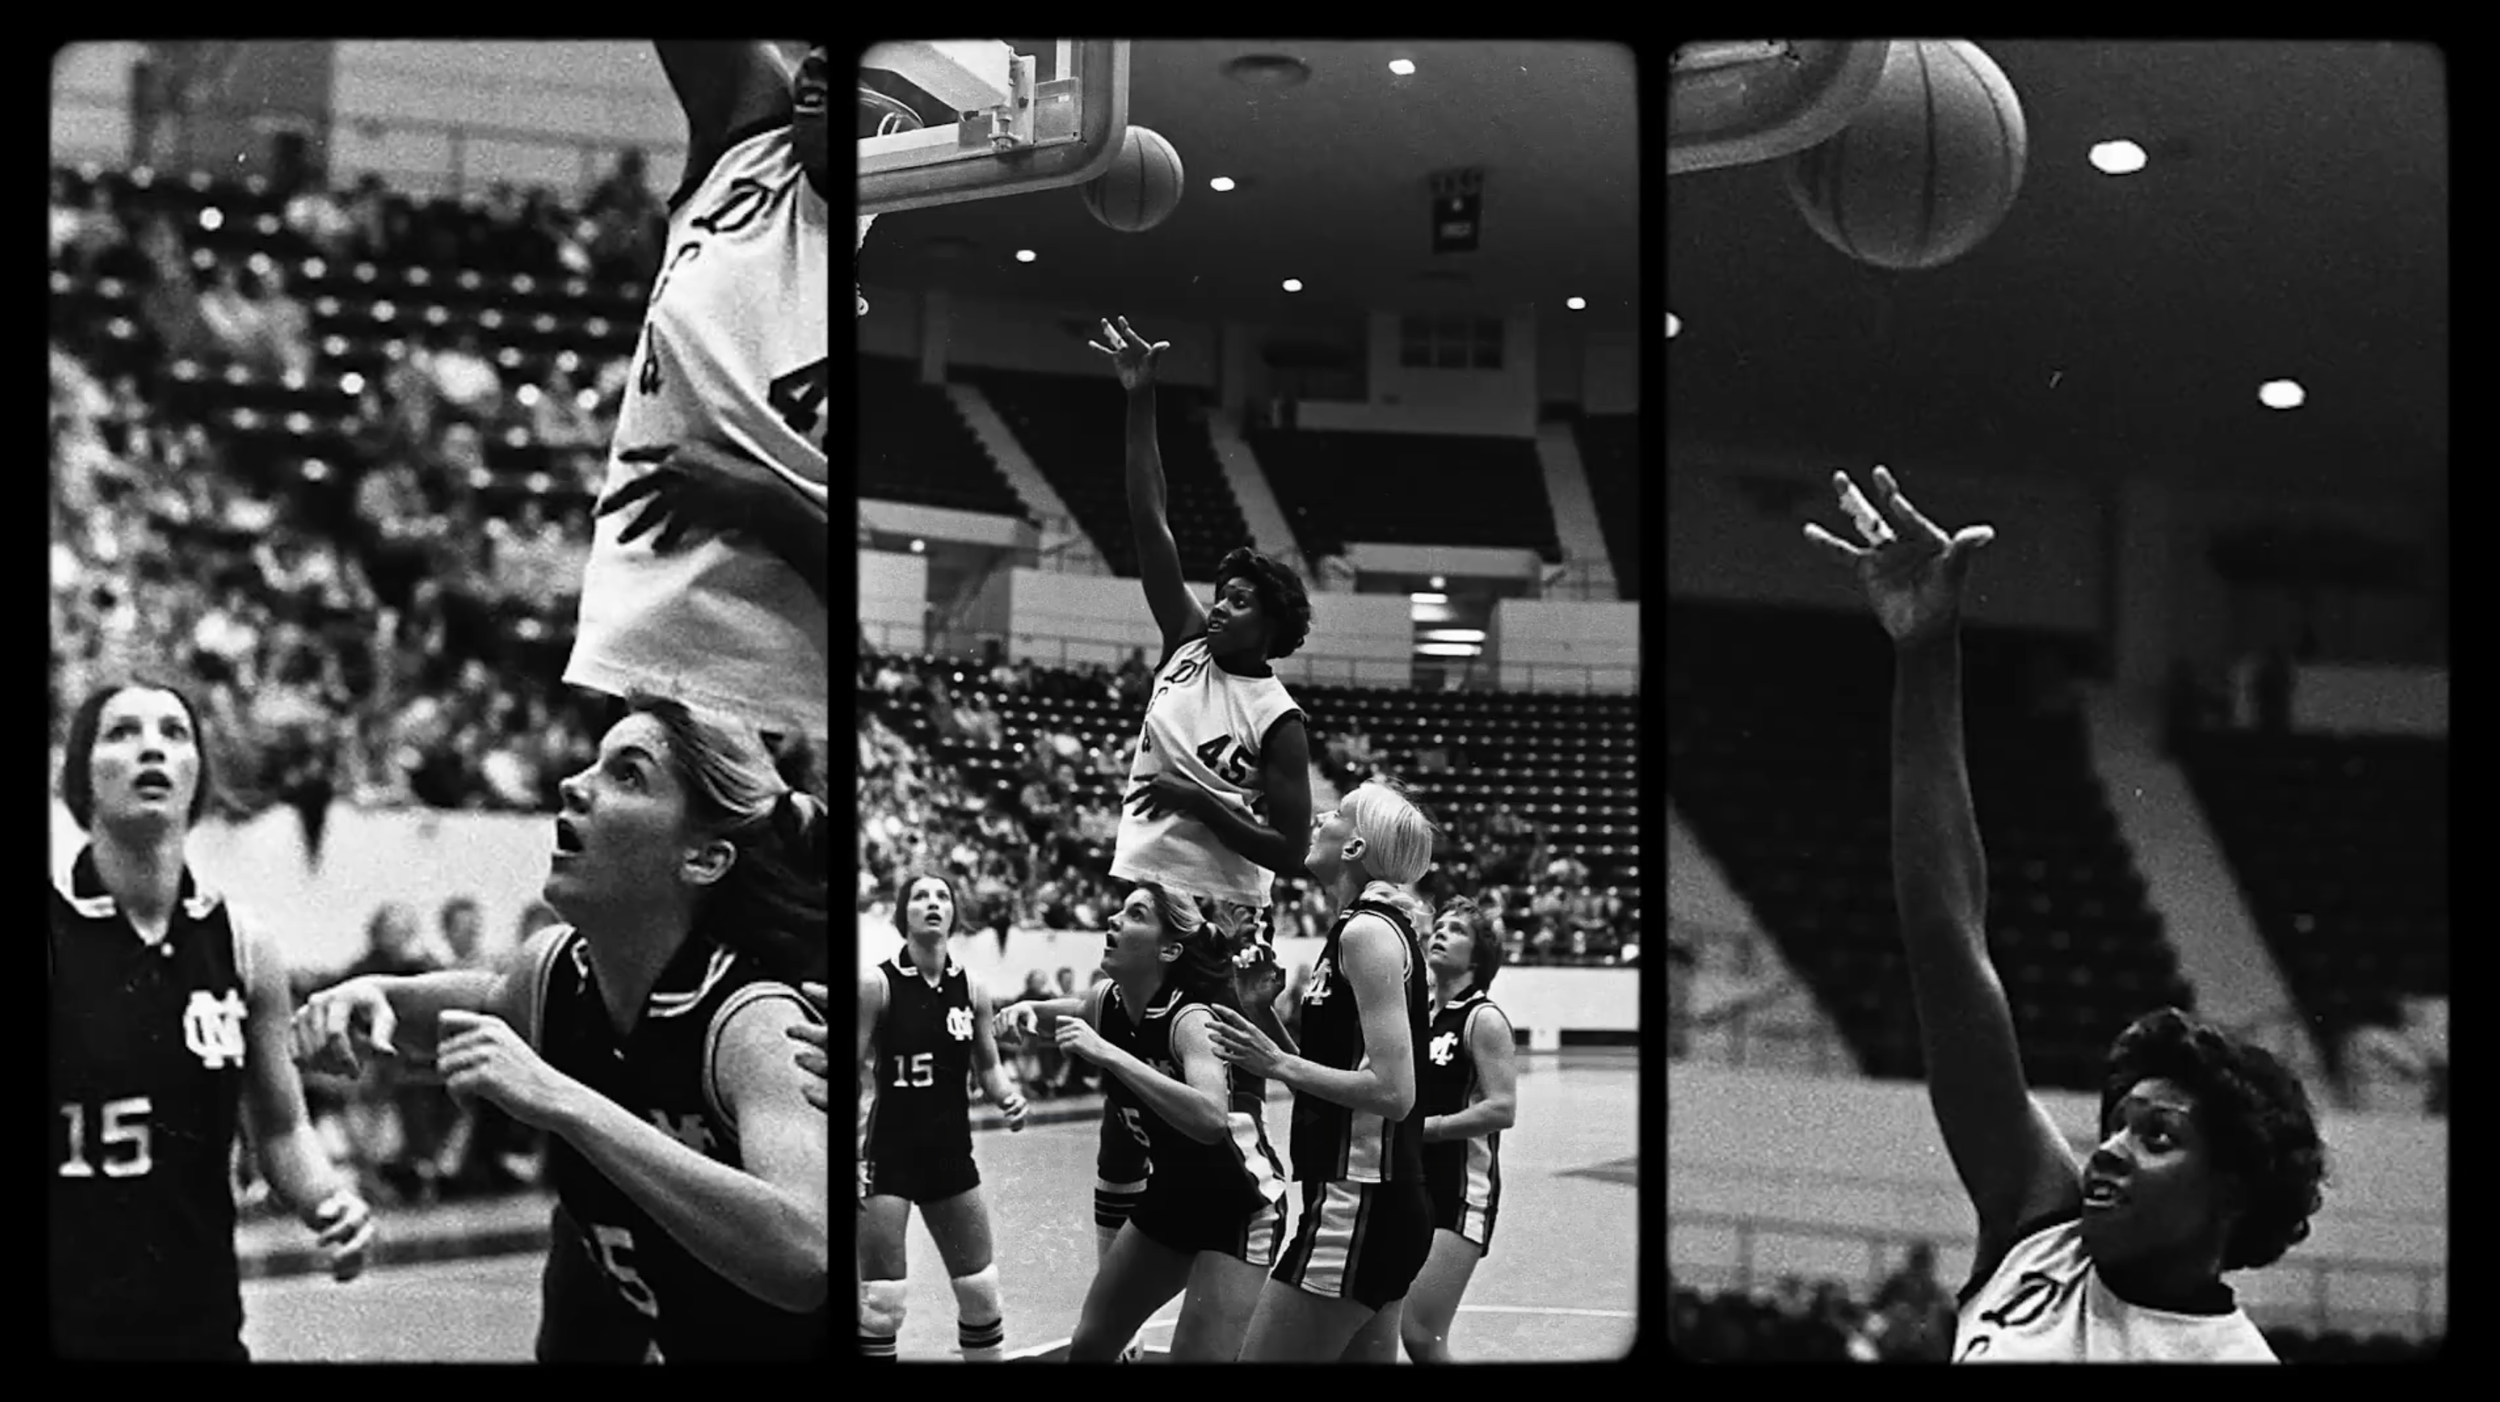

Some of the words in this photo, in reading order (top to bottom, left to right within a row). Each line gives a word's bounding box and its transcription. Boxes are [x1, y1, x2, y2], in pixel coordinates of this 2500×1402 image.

[1196, 733, 1260, 786] 45
[892, 1051, 935, 1088] 15
[58, 1097, 153, 1178] 15
